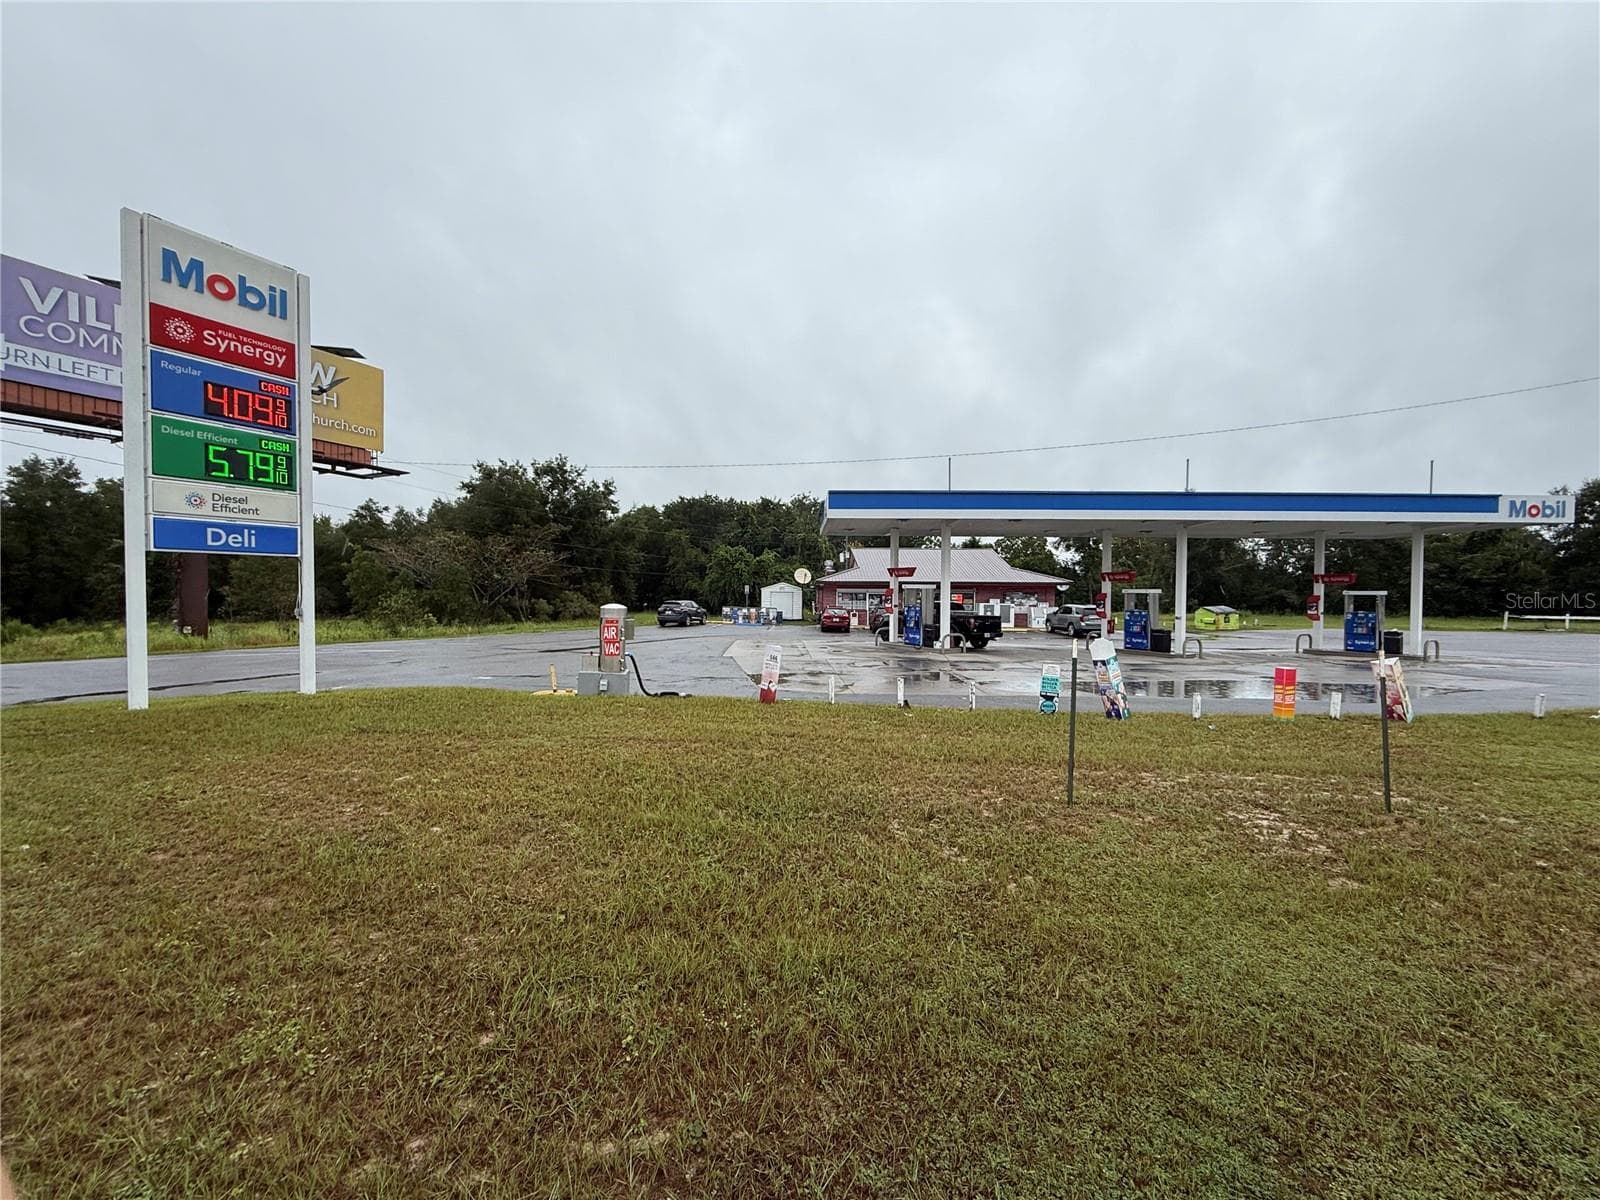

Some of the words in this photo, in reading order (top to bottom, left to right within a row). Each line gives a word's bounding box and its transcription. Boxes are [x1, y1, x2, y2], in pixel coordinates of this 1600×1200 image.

[161, 246, 288, 320] Mobil
[202, 329, 287, 368] Synergy
[218, 329, 237, 341] FUEL
[239, 334, 287, 353] TECHNOLOGY
[58, 358, 114, 382] LEFT
[160, 360, 203, 377] Regular
[260, 381, 290, 396] CASH
[161, 425, 195, 439] Diesel
[196, 431, 239, 445] Efficient
[260, 439, 290, 453] CASH
[211, 492, 249, 505] Diesel
[211, 503, 261, 516] Efficient
[1508, 500, 1566, 518] Mobil
[206, 527, 257, 548] Deli
[603, 626, 617, 640] AIR
[604, 642, 620, 655] VAC
